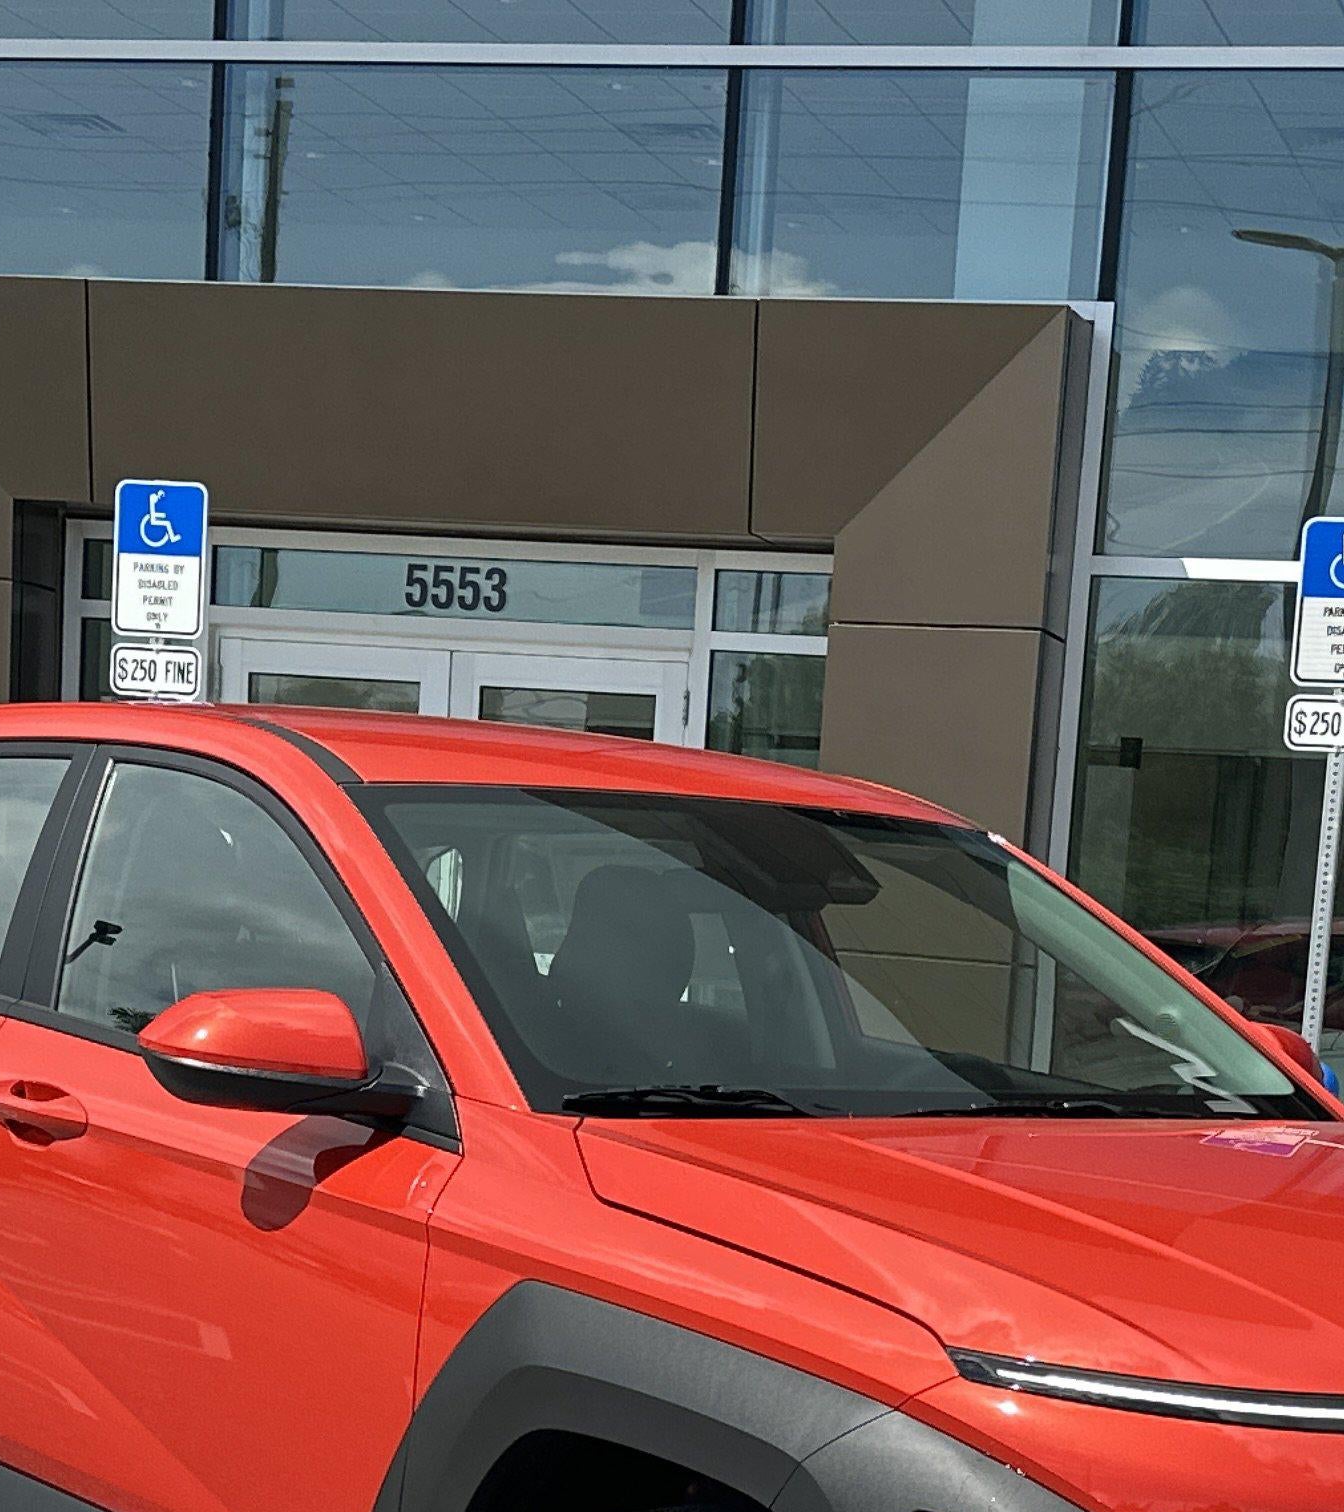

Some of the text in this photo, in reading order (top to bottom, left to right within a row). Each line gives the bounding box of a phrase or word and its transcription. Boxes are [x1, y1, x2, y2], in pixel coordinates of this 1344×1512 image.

[133, 562, 185, 575] PARKING BY
[138, 579, 179, 591] DISABLED
[405, 563, 507, 612] 5553
[142, 595, 173, 606] PERMIT
[117, 657, 194, 684] $250 FINE
[1293, 709, 1342, 737] $250
